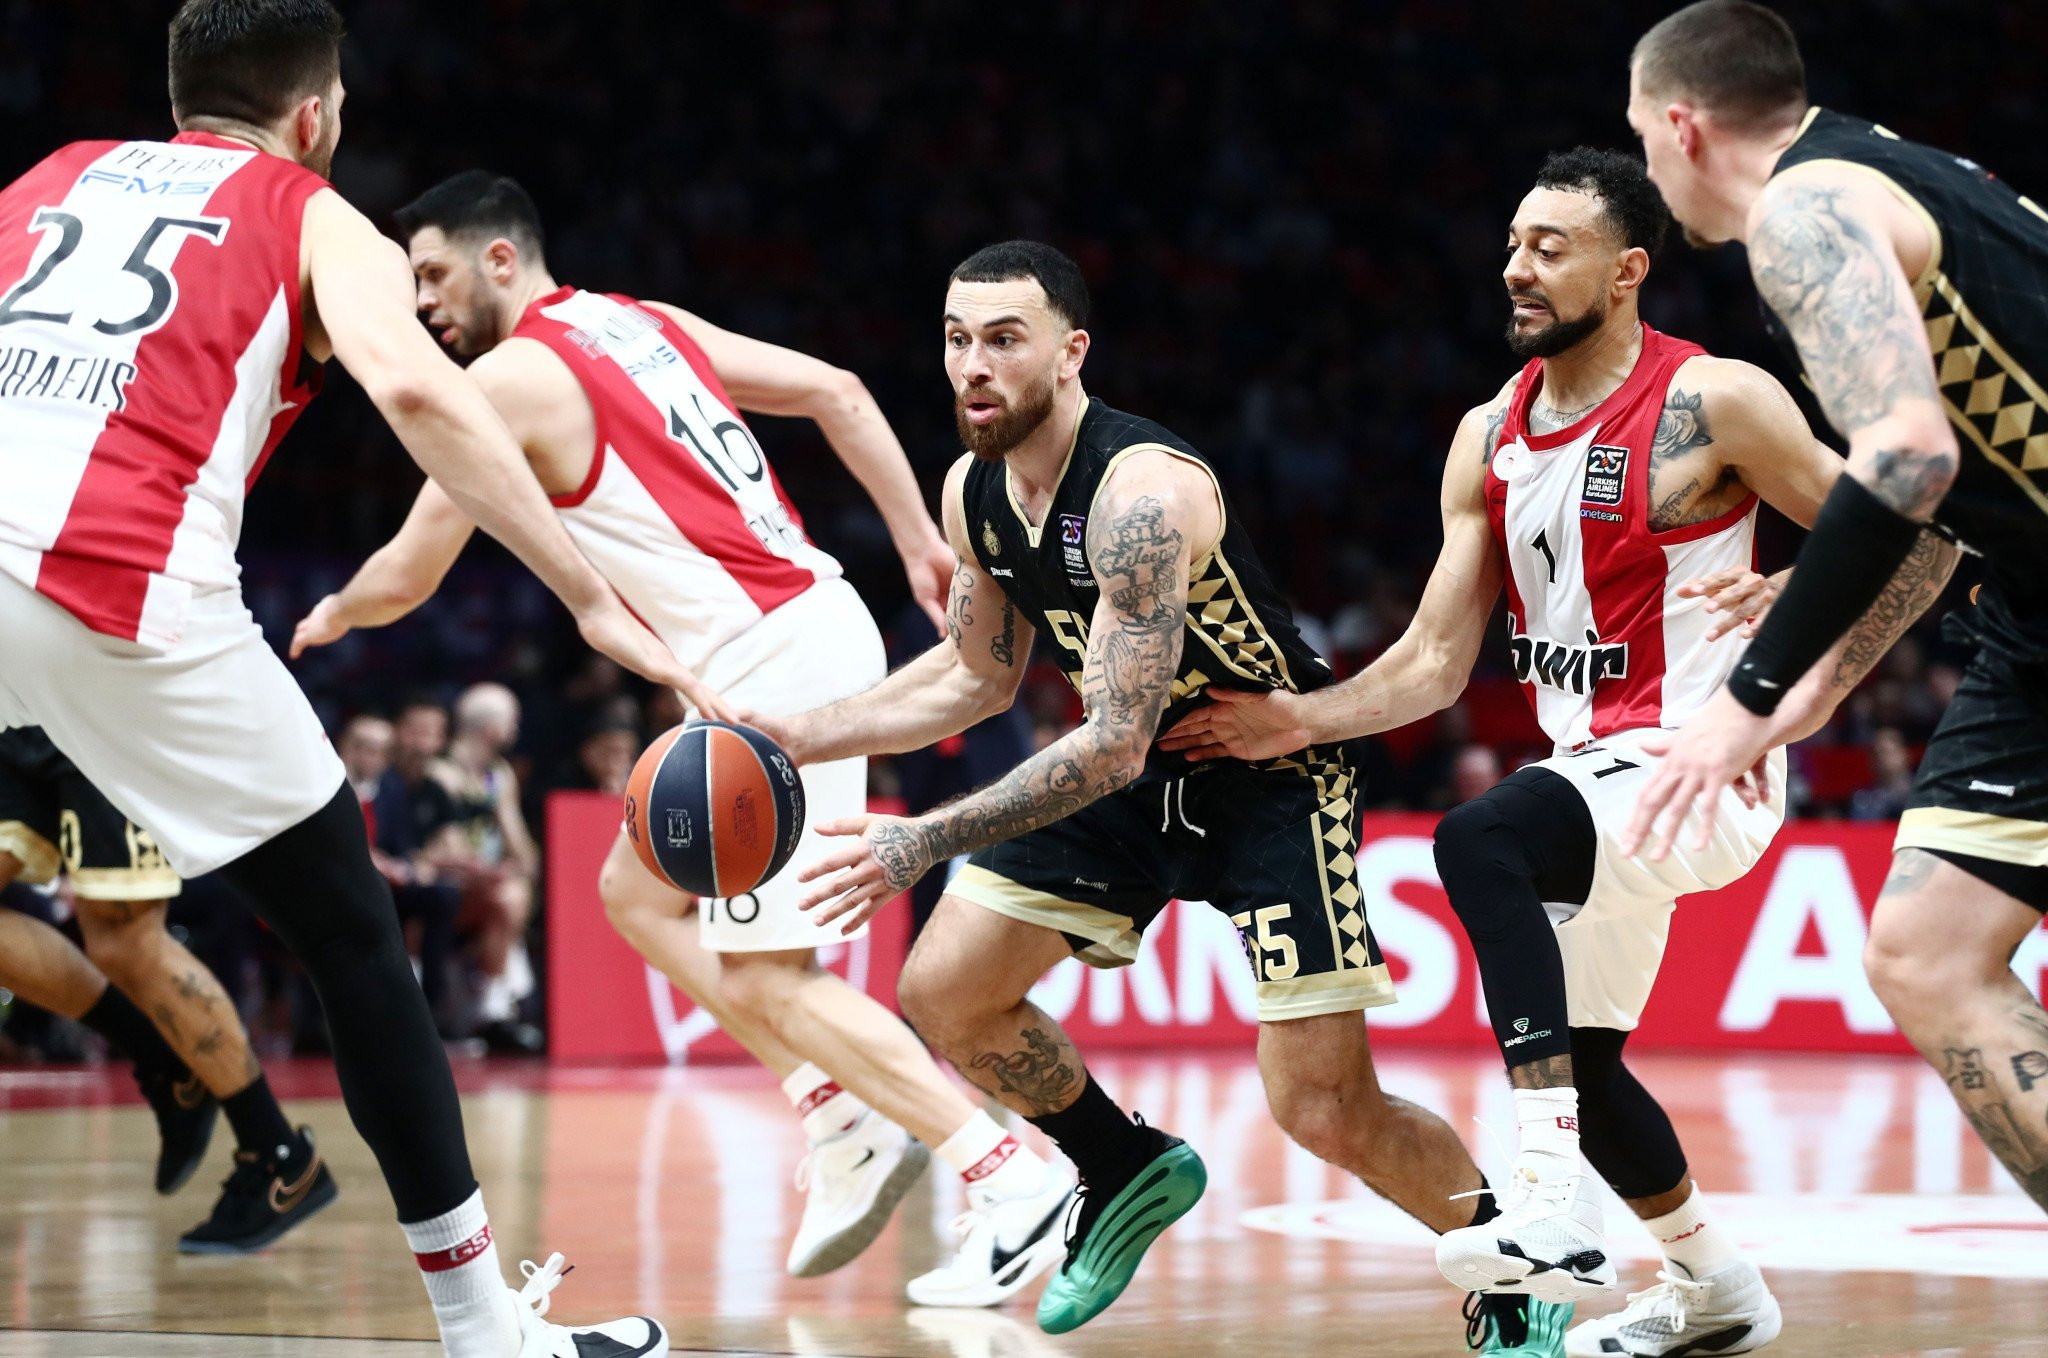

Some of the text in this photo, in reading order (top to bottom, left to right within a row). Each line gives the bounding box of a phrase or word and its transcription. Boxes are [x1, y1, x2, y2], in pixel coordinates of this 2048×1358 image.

[80, 170, 215, 195] FMS
[0, 210, 223, 336] 25
[669, 393, 764, 492] 16
[1588, 450, 1624, 475] 25
[1587, 484, 1618, 494] AIRLINES
[1588, 477, 1618, 486] TURKISH
[1580, 509, 1623, 522] oneteam
[1531, 528, 1557, 584] 1
[1507, 612, 1628, 697] bwin
[1504, 1028, 1552, 1048] GAMEPATCH
[1556, 1116, 1579, 1132] GS
